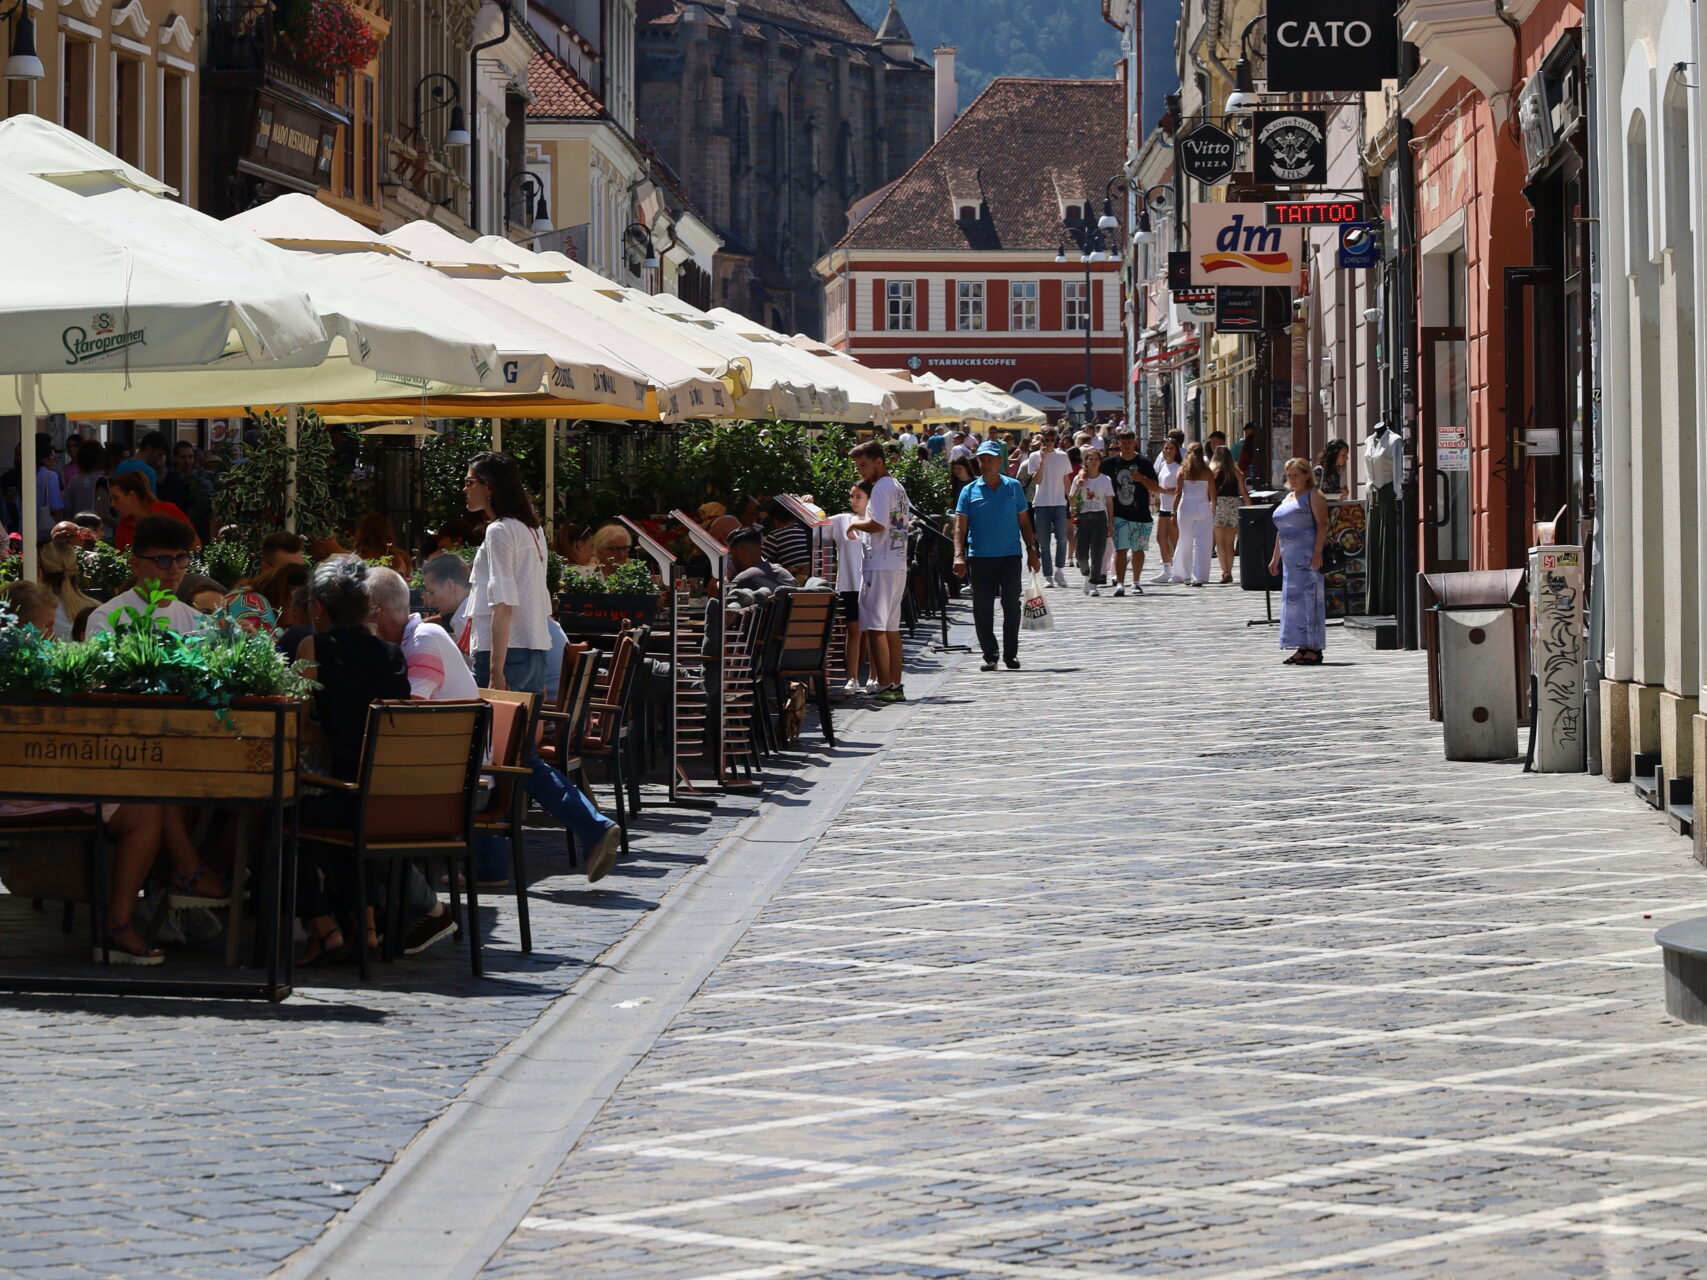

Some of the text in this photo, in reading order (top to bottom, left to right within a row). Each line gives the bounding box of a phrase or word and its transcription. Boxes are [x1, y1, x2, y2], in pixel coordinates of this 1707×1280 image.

[1277, 20, 1372, 48] CATO
[287, 128, 319, 158] RESTAURANT
[1187, 139, 1230, 155] Vitto
[1194, 160, 1228, 168] PIZZA
[1281, 169, 1305, 179] INK
[1275, 204, 1356, 223] TATTOO
[1216, 214, 1282, 252] dm
[1344, 255, 1370, 265] pepsi
[62, 326, 145, 365] Staropramen
[928, 358, 1017, 366] STARBUCKS COFFEE
